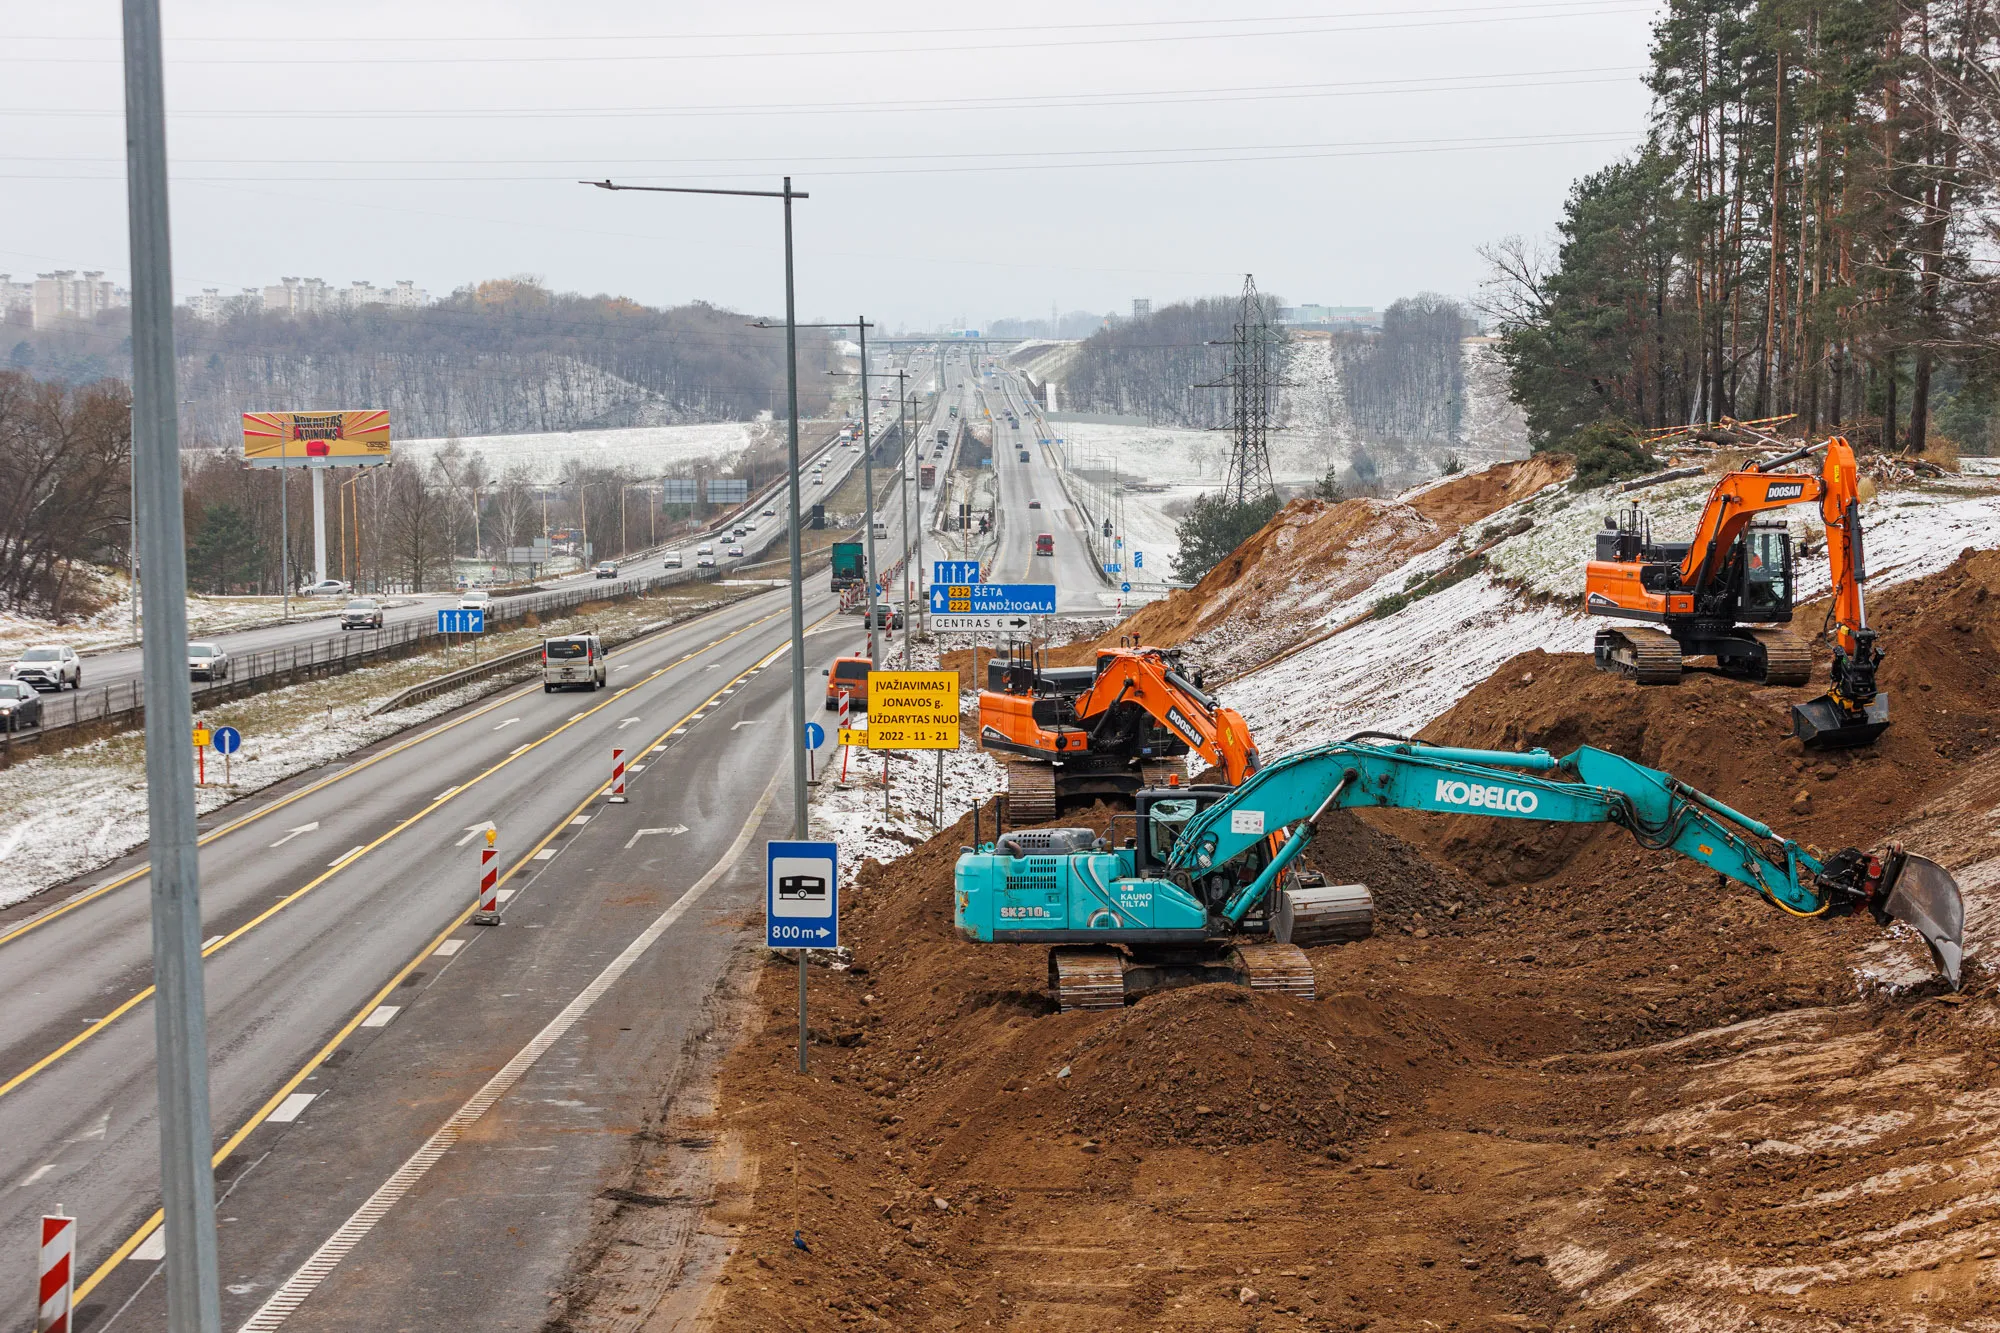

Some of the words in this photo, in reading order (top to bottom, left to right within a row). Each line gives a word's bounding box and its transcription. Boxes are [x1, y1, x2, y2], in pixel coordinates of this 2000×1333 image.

[293, 413, 343, 428] NOKAUTAS
[299, 428, 338, 441] KAINOMS
[1768, 485, 1801, 498] DOOSAN
[950, 587, 970, 597] 232
[974, 586, 1003, 597] ŠĖTA
[950, 602, 970, 611] 222
[974, 599, 1053, 611] VANDŽIOGALA
[936, 618, 991, 628] CENTRAS
[997, 619, 1003, 628] 6
[875, 680, 945, 692] ĮVAŽIAVIMAS
[882, 698, 932, 707] JONAVOS
[934, 700, 944, 709] g.
[869, 713, 930, 724] UŽDARYTAS
[933, 715, 958, 724] NUO
[1169, 709, 1202, 747] DOOSAN
[879, 731, 904, 740] 2022
[1435, 779, 1538, 814] KOBELCO
[1120, 900, 1149, 908] TILTAI
